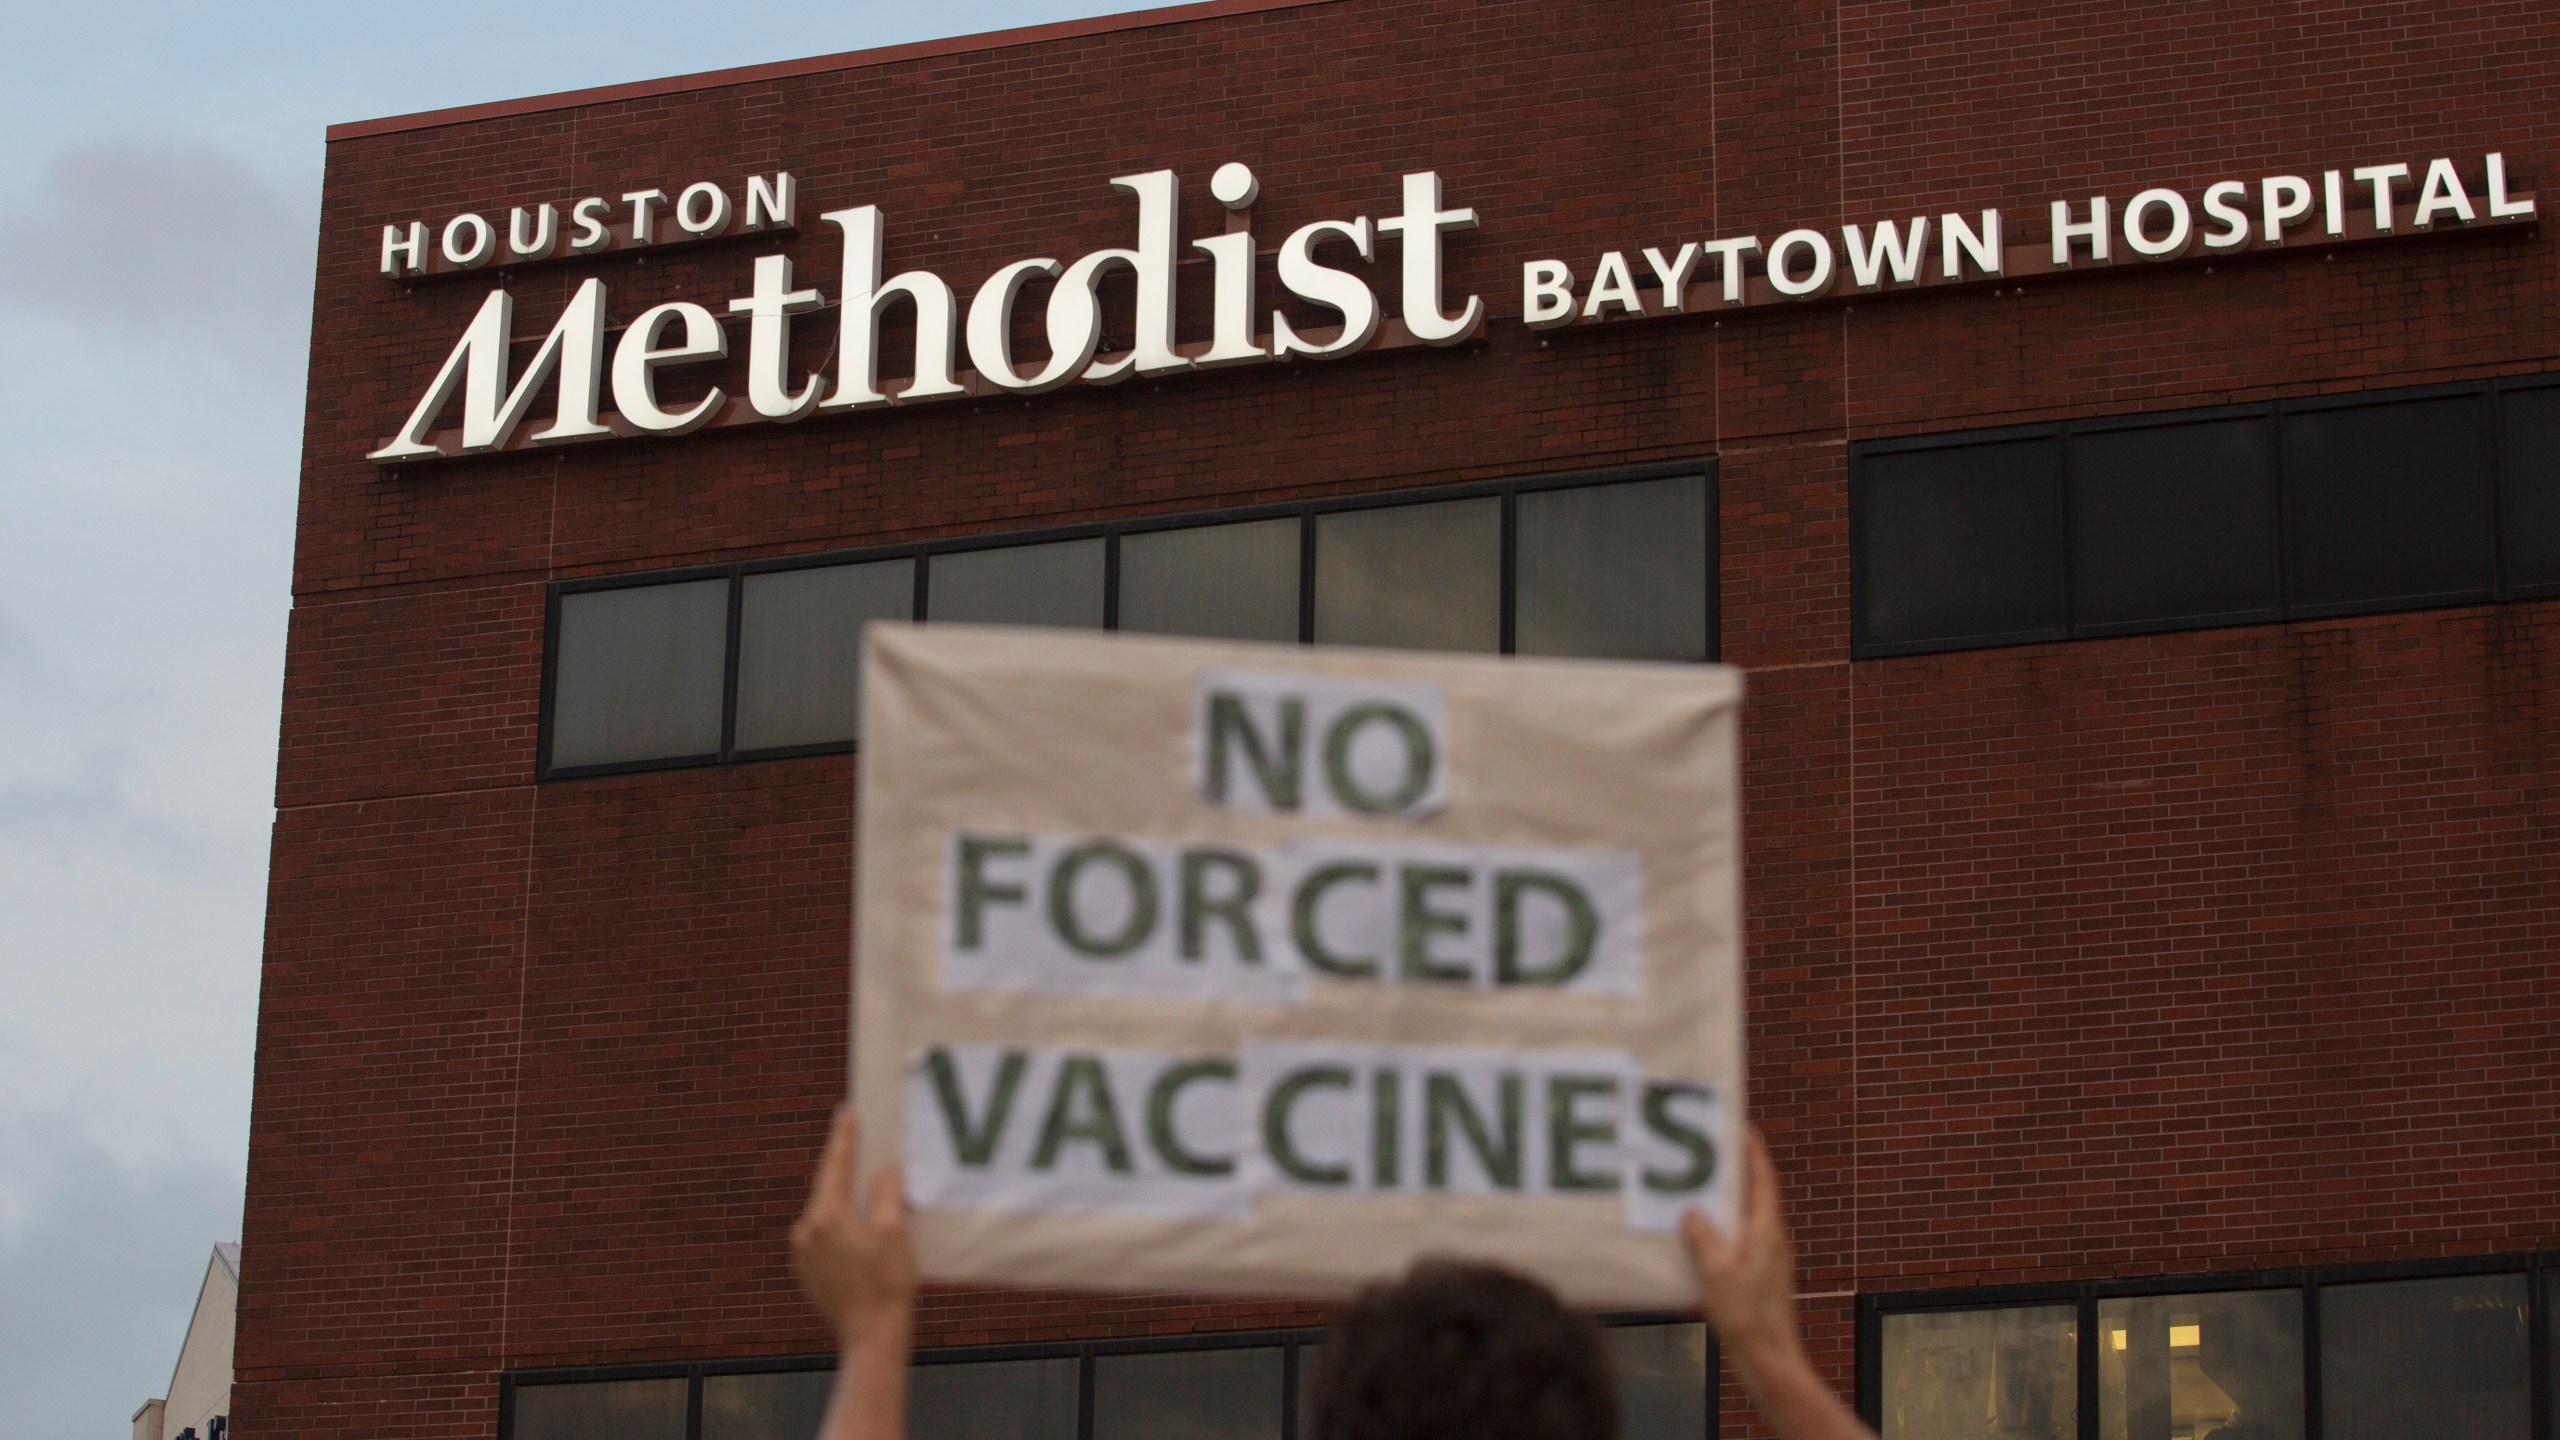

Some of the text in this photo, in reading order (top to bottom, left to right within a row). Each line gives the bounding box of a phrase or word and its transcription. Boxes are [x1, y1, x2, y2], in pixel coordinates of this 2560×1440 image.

[380, 171, 796, 278] HOUSTON
[1523, 152, 2537, 330] BAYTOWN HOSPITAL
[366, 162, 1484, 462] Methodist
[1205, 689, 1438, 813] NO
[954, 837, 1600, 987] FORCED
[922, 1042, 1719, 1195] VACCINES
